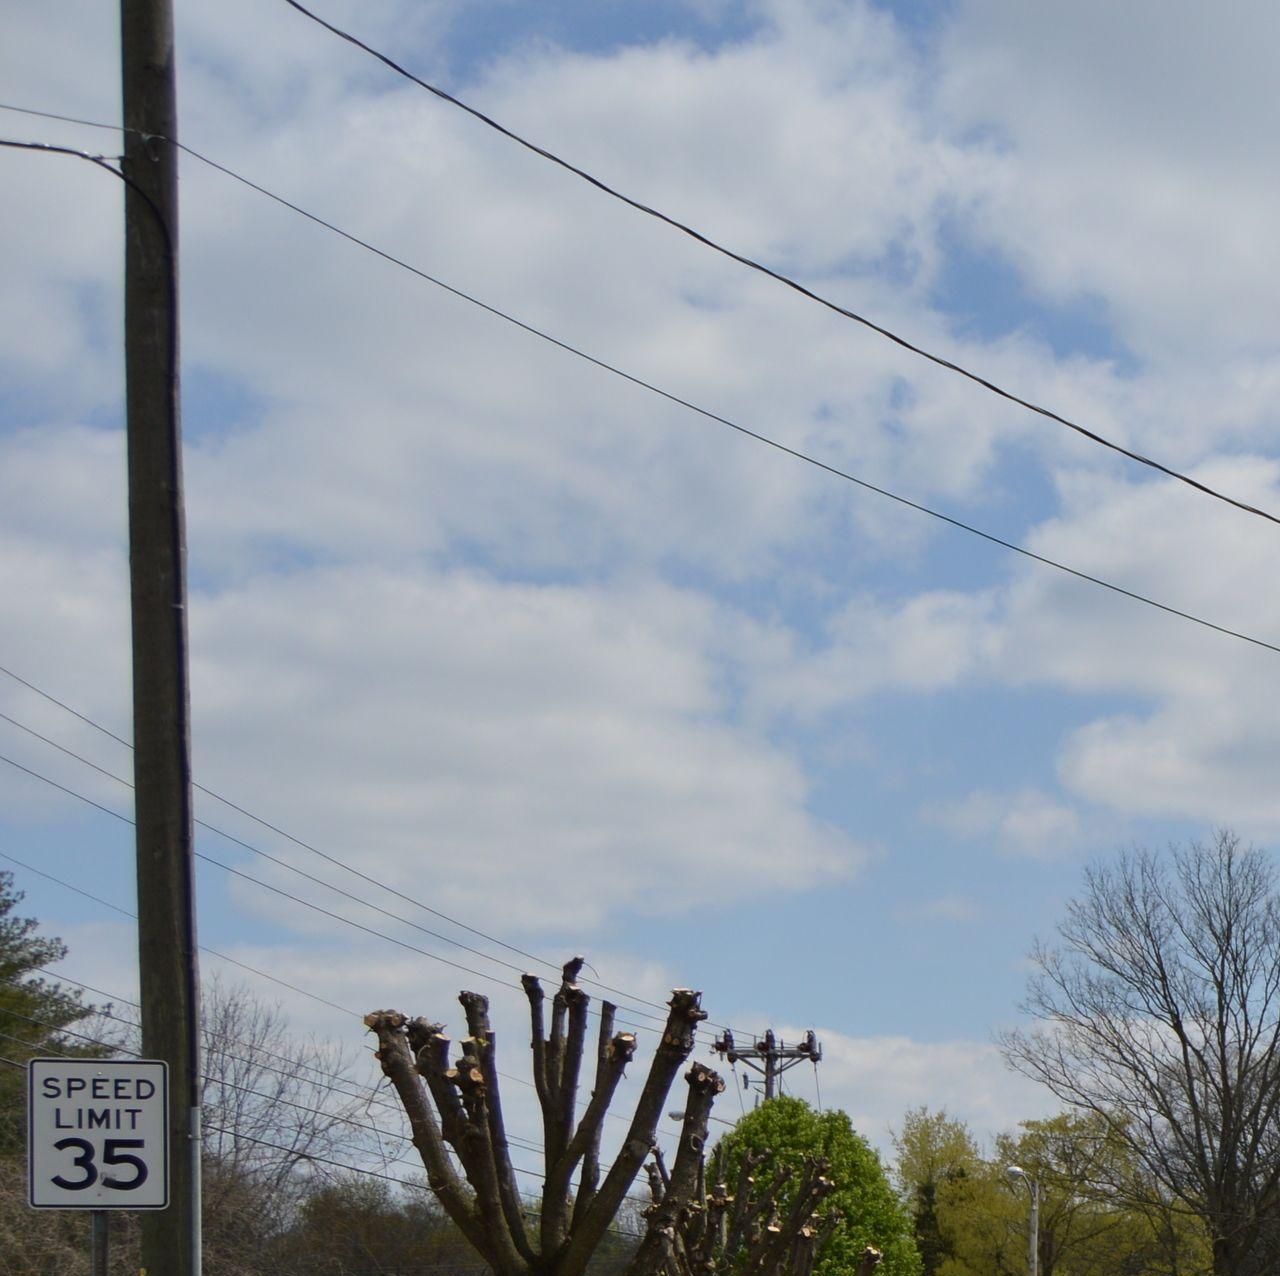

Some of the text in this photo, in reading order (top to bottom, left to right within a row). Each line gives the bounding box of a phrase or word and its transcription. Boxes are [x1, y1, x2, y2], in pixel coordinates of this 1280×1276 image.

[42, 1077, 156, 1100] SPEED
[55, 1108, 142, 1130] LIMIT
[50, 1137, 149, 1191] 35
